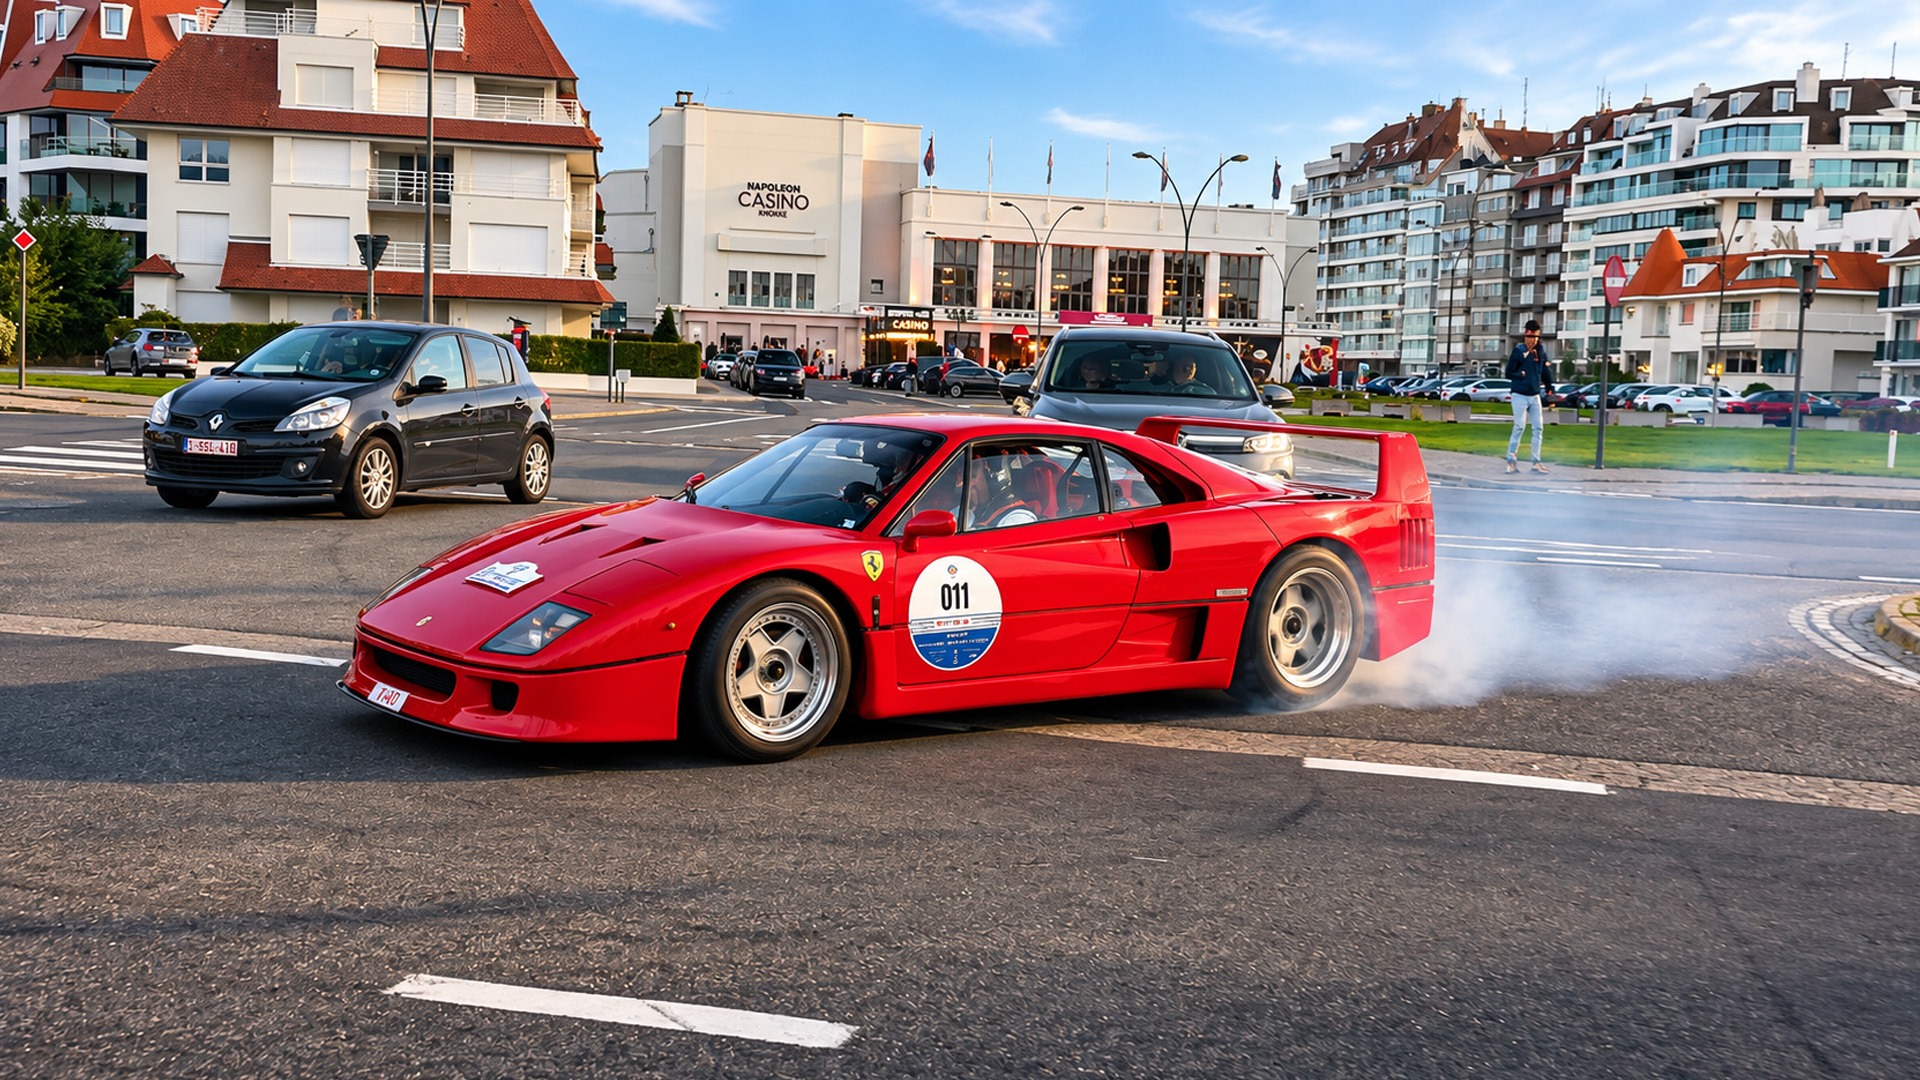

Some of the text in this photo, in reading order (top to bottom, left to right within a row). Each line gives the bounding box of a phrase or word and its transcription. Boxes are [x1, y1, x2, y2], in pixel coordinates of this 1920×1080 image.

[747, 182, 801, 193] NAPOLEON
[738, 191, 809, 210] CASINO
[892, 320, 929, 330] CASINO
[941, 582, 969, 610] 011
